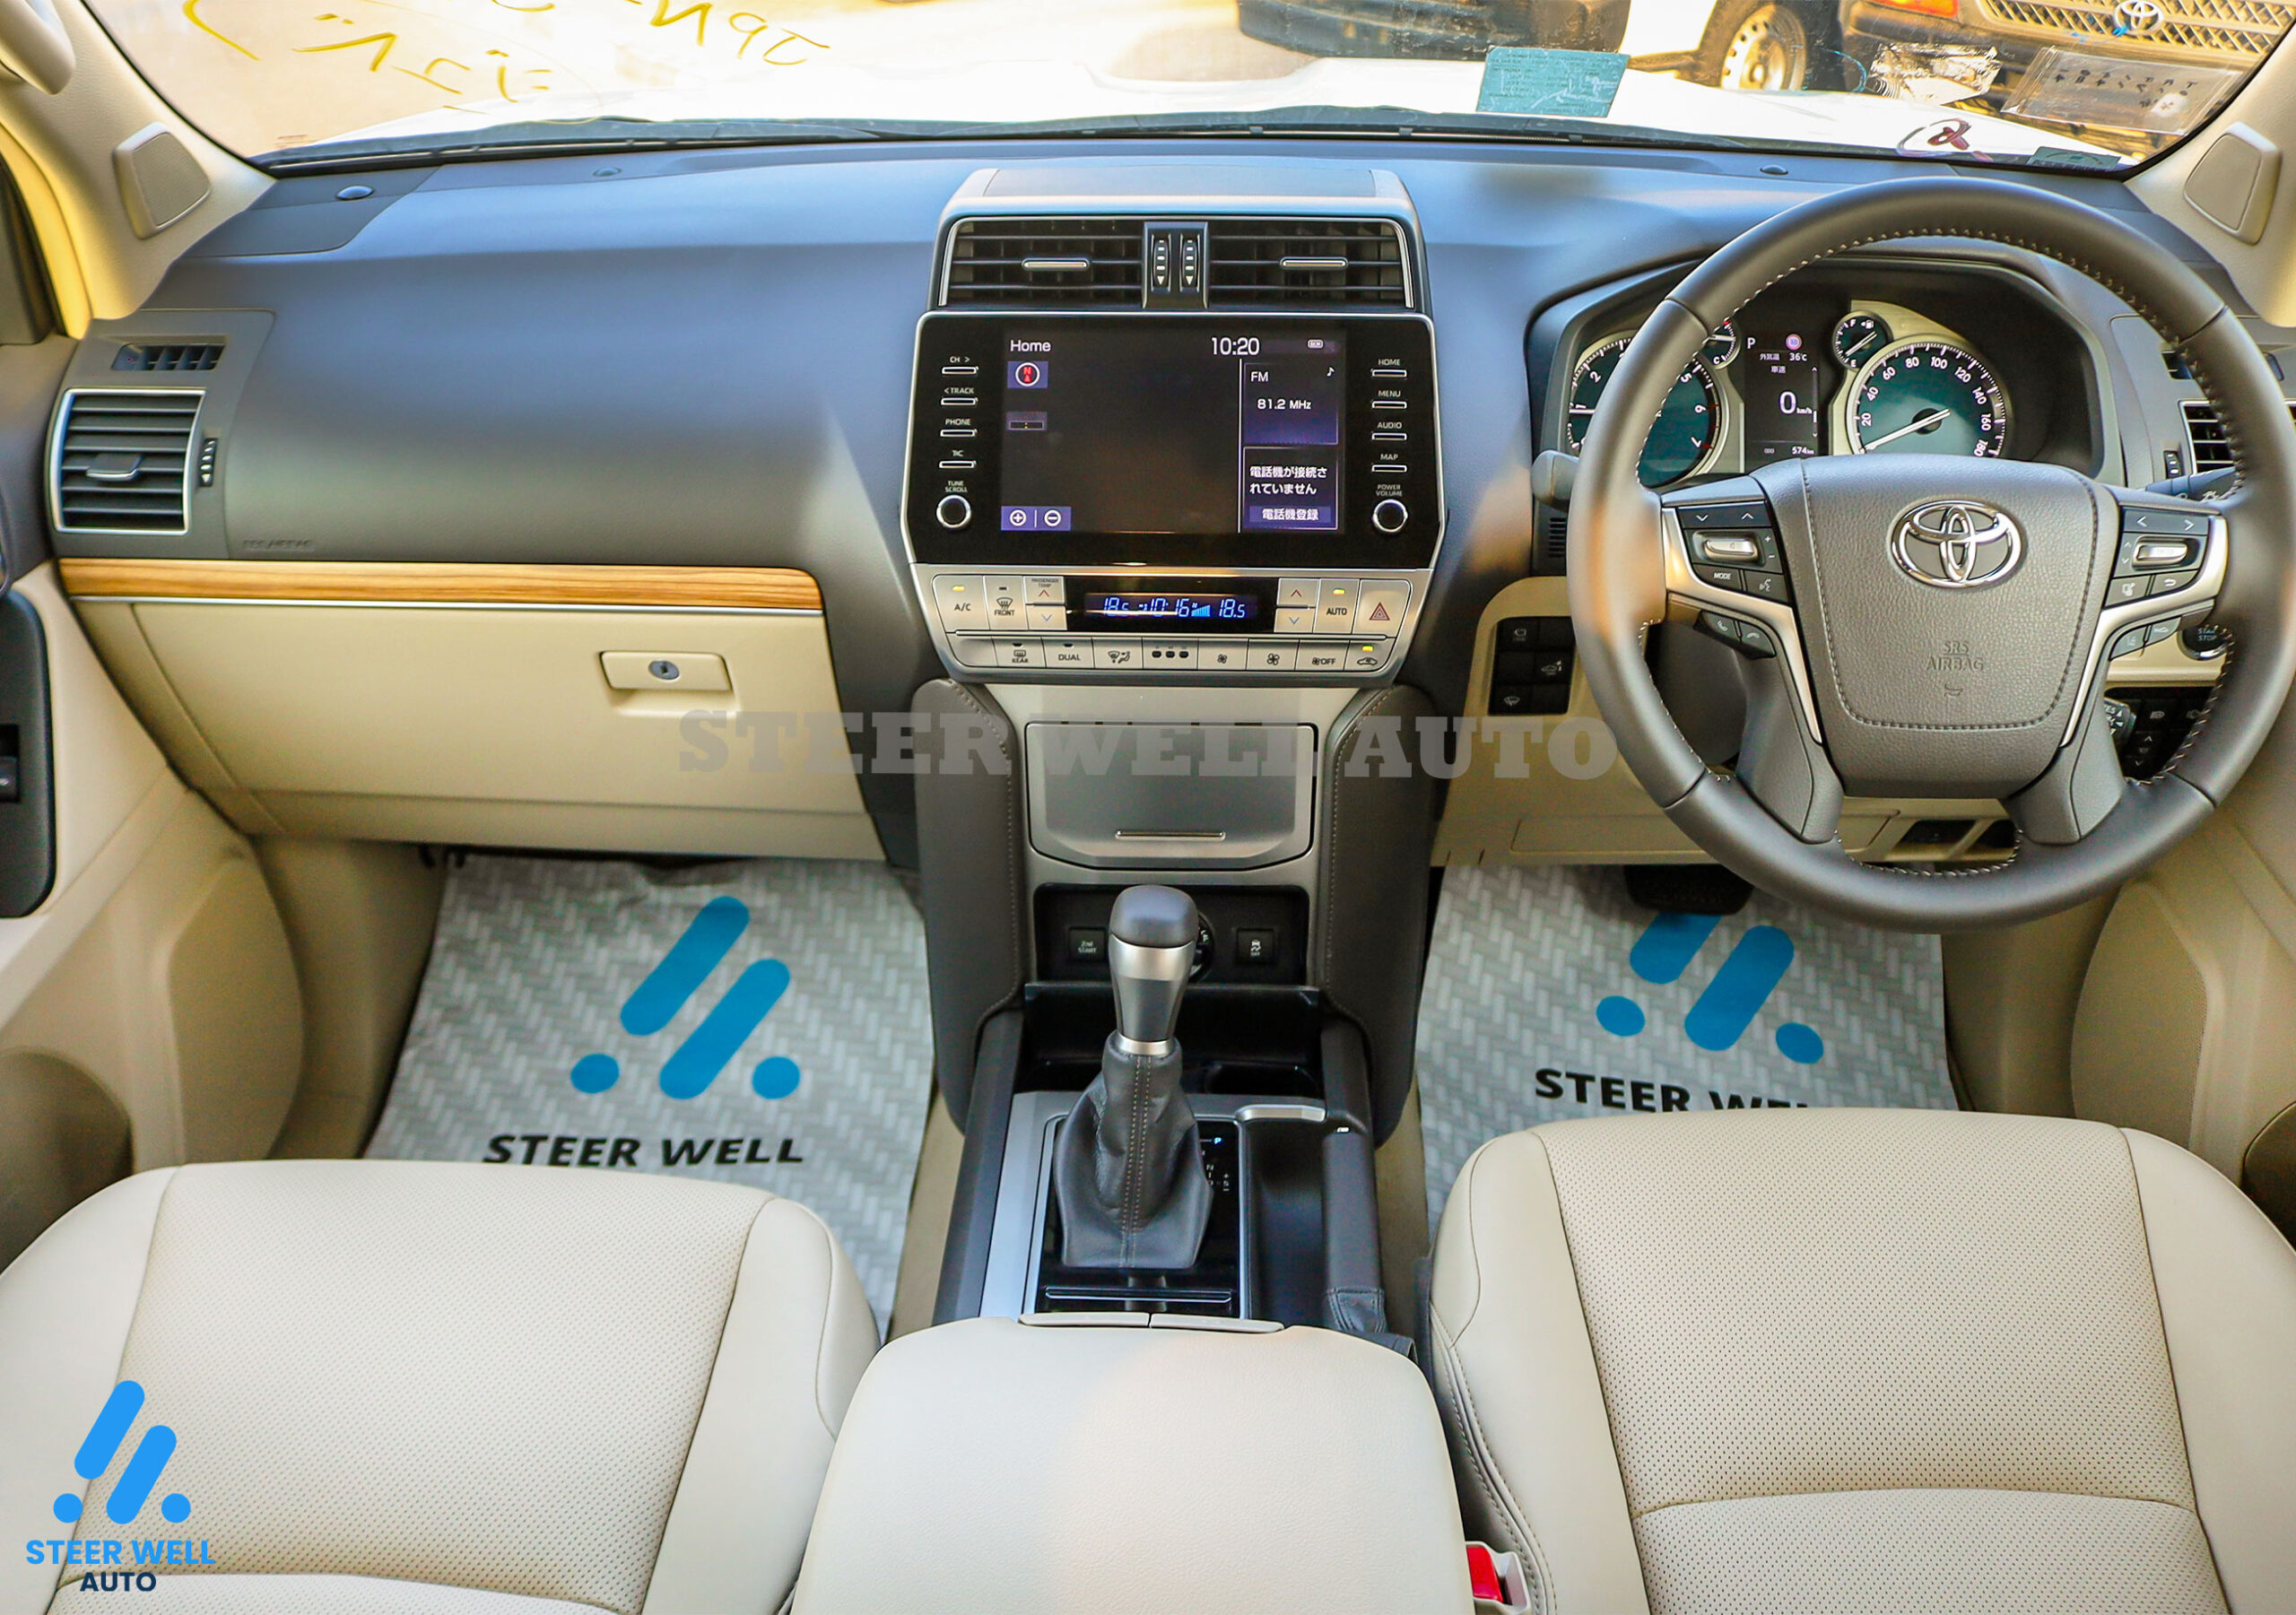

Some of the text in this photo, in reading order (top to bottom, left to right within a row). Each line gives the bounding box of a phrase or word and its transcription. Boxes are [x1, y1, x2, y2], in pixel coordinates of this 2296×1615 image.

[1849, 318, 1857, 327] F
[1010, 339, 1052, 352] Home
[1211, 336, 1260, 356] 10:20
[1747, 337, 1756, 350] P
[1378, 359, 1401, 367] HOME
[1850, 359, 1857, 368] E
[1905, 356, 1920, 369] 80
[1930, 356, 1948, 369] 100
[1250, 370, 1269, 382] FM
[1590, 371, 1602, 383] 2
[1680, 372, 1692, 384] 5
[1883, 366, 1896, 381] 60
[1954, 366, 1971, 384] 120
[1378, 390, 1401, 398] MENU
[1866, 386, 1879, 402] 40
[1972, 386, 1987, 405] 140
[1257, 398, 1312, 411] 81.2 MHz
[1694, 404, 1707, 414] 6
[1779, 390, 1797, 415] 0
[945, 418, 971, 426] PHONE
[1377, 421, 1403, 430] AUDIO
[1861, 412, 1872, 427] 20
[1980, 413, 1991, 431] 160
[1691, 436, 1702, 448] 7
[1974, 438, 1988, 457] 180
[1380, 453, 1398, 461] MAP
[1249, 465, 1328, 479] 電話機が接続さ
[1249, 482, 1318, 495] れていません
[1261, 508, 1319, 521] 電話機登録
[1714, 572, 1732, 580] MODE
[954, 603, 971, 612] A/C
[995, 609, 1014, 617] FRONT
[1219, 599, 1246, 618] 18.5
[1326, 607, 1347, 616] AUTO
[1944, 640, 1970, 654] SRS
[1320, 657, 1336, 665] OFF
[1926, 656, 1985, 671] AIRBAG
[1535, 1067, 1690, 1113] STEER
[482, 1134, 803, 1168] STEER WELL
